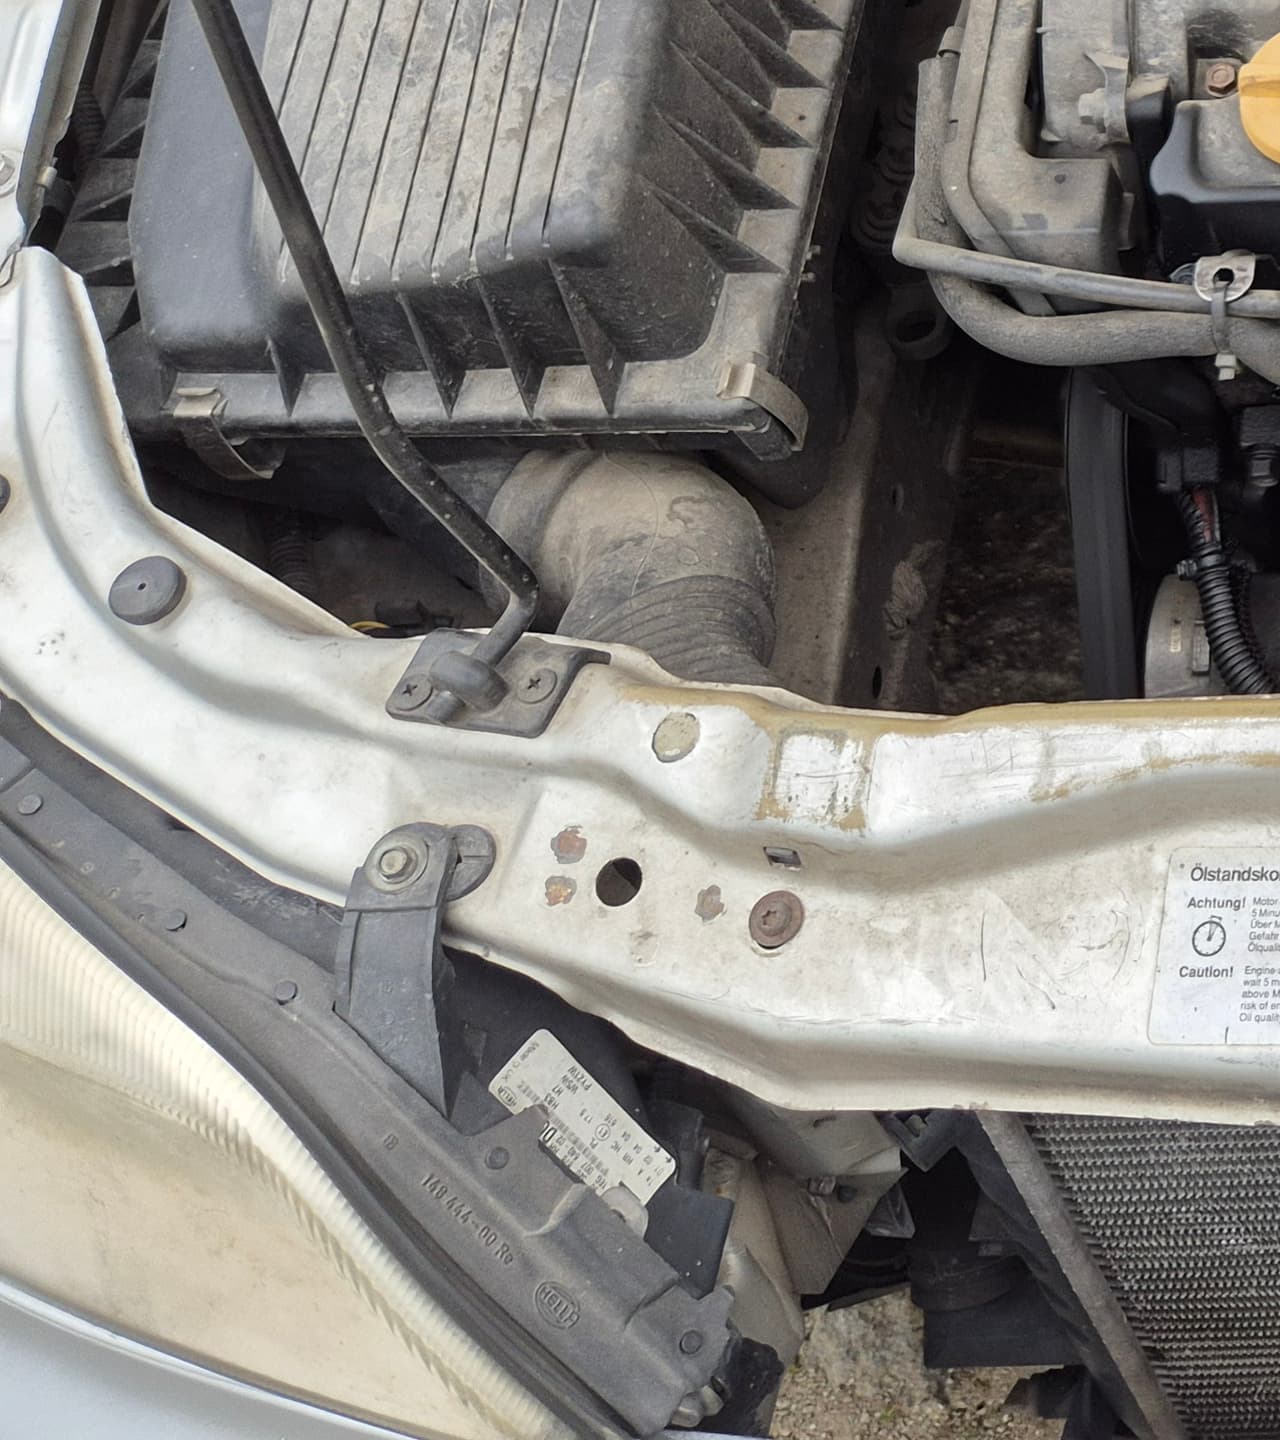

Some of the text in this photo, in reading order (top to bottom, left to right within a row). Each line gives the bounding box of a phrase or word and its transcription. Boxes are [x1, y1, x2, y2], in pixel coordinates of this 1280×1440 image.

[1186, 896, 1247, 910] Achtung!
[1253, 897, 1278, 906] Motor
[1251, 909, 1258, 917] 5
[1250, 918, 1272, 928] Über
[1249, 932, 1279, 940] Gefahr
[1178, 966, 1234, 978] Caution!
[1244, 967, 1275, 977] Engine
[1243, 978, 1261, 986] wait
[1264, 978, 1269, 986] 5
[1242, 990, 1269, 998] above
[1240, 1002, 1256, 1010] risk
[1259, 1002, 1269, 1010] of
[1239, 1013, 1252, 1022] Oil
[567, 1065, 593, 1091] PY21W
[421, 1173, 448, 1200] 148
[539, 1285, 581, 1330] HELLA
